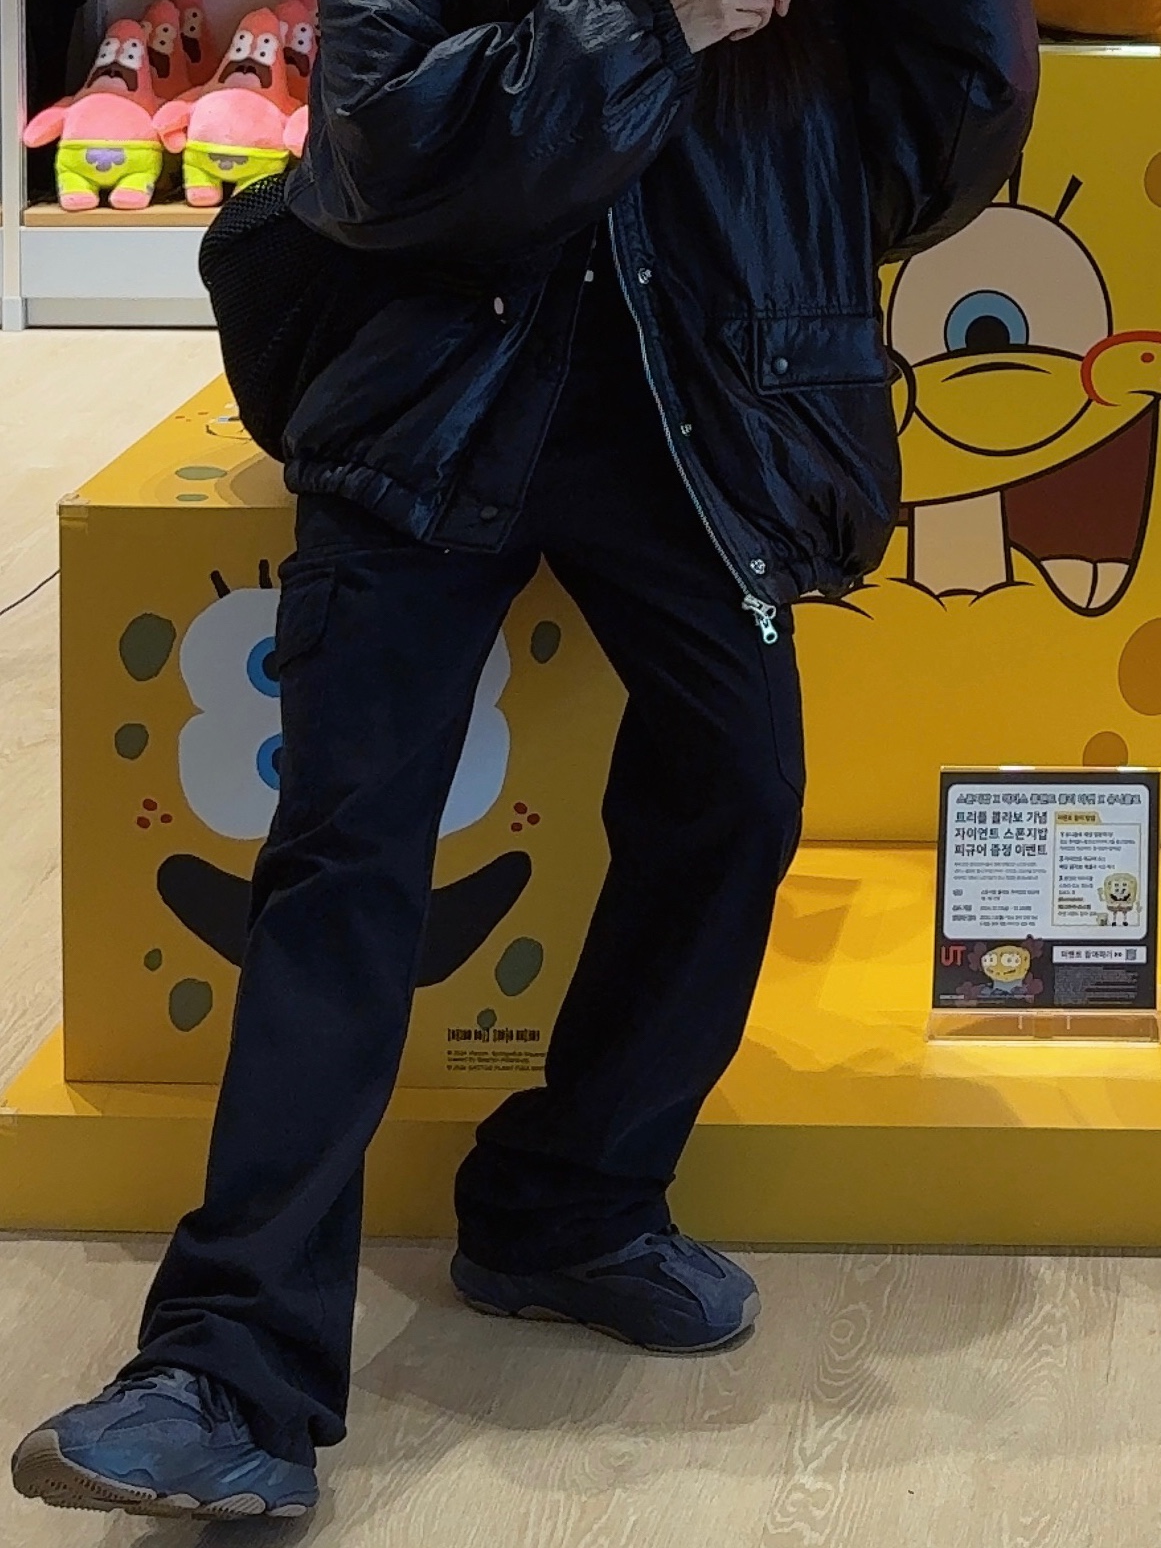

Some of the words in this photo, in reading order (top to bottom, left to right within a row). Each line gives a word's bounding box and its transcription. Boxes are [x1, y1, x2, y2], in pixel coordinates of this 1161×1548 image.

[955, 811, 987, 824] 트리플
[992, 811, 1023, 824] 콜라보
[1026, 811, 1048, 824] 기념
[955, 828, 1000, 840] 자이언트
[1003, 828, 1048, 840] 스폰지밥
[954, 843, 987, 856] 피규어
[990, 843, 1012, 857] 증정
[1015, 843, 1048, 856] 이벤트
[940, 945, 967, 967] UT
